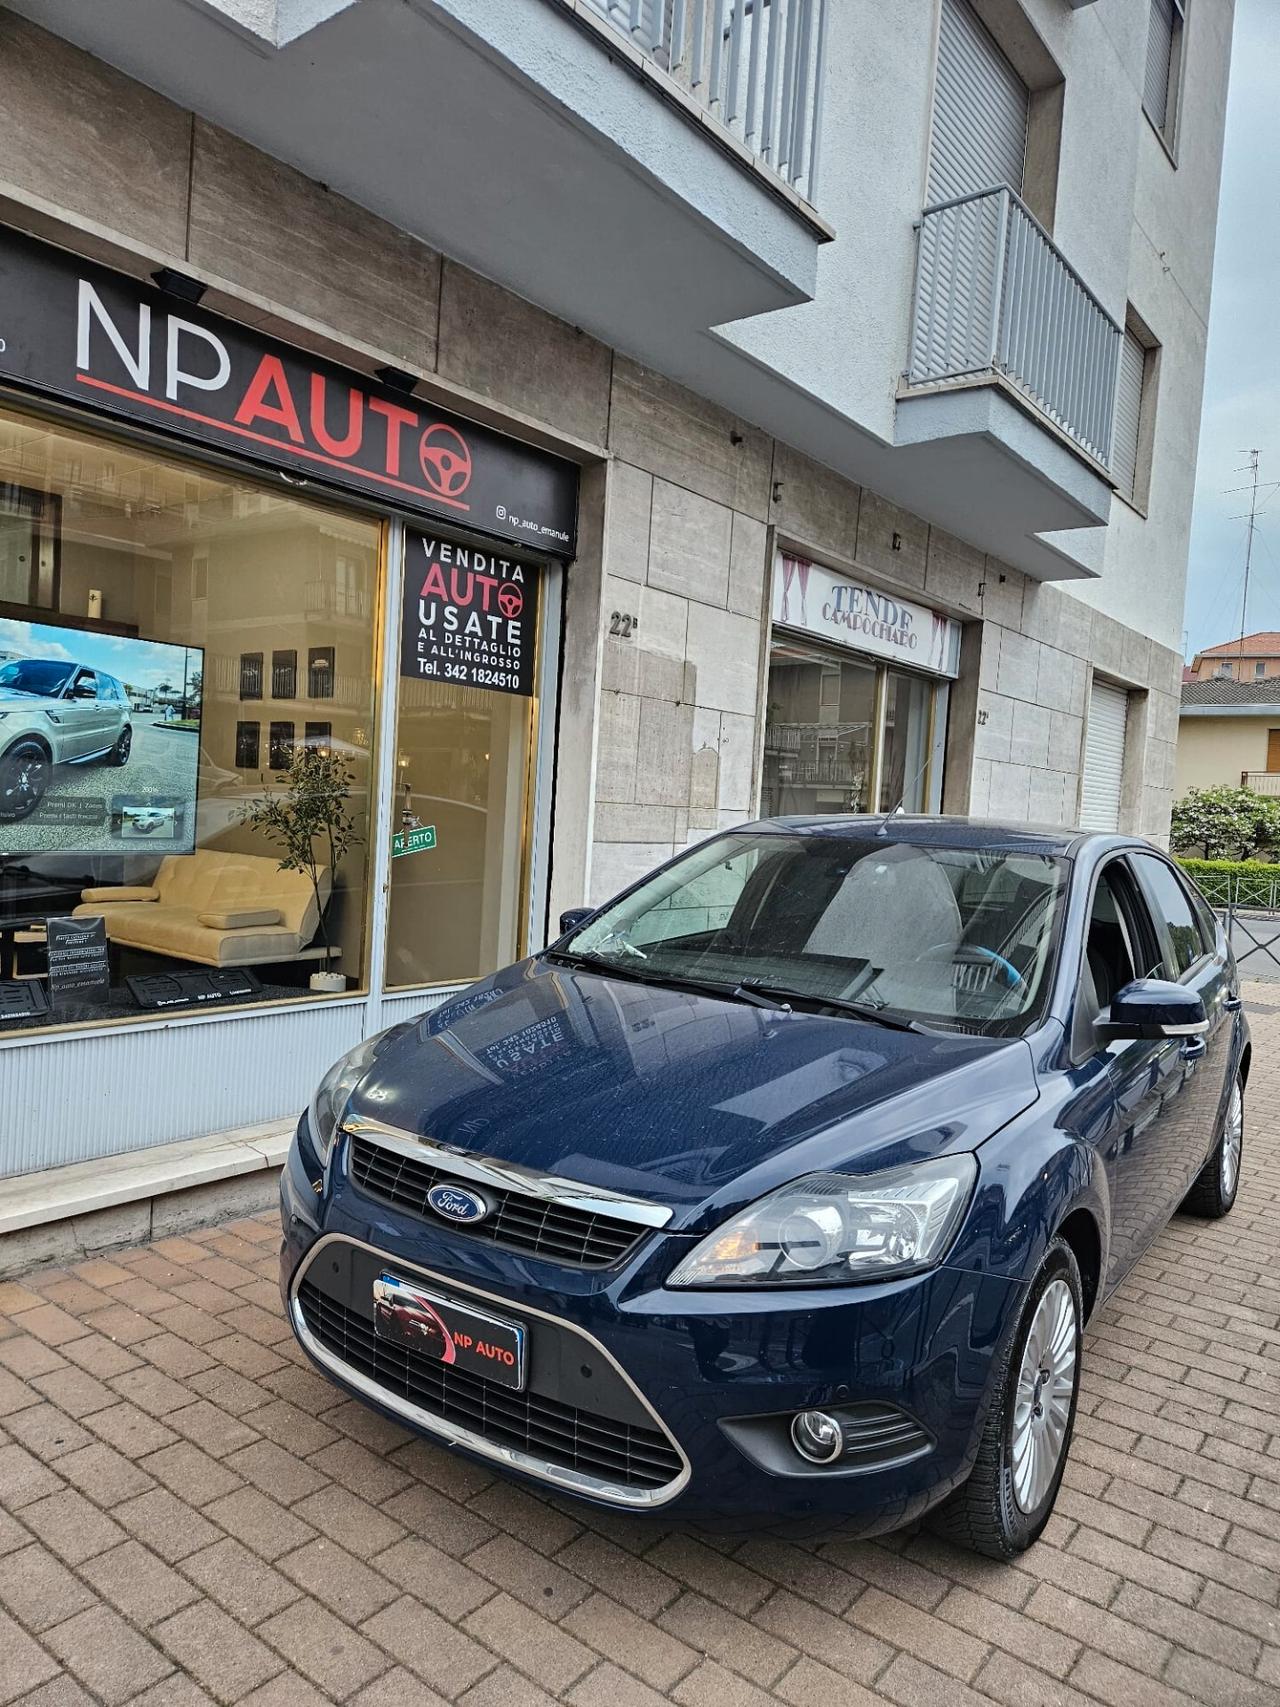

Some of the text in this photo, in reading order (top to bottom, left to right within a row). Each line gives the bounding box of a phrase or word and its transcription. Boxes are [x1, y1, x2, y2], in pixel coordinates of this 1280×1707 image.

[76, 279, 471, 497] NP AUTO
[422, 537, 524, 583] VENDITA
[420, 563, 523, 618] AUTO
[831, 585, 913, 630] TENDE
[418, 599, 521, 645] USATE
[418, 628, 521, 657] AL DETTAGLIO
[418, 642, 520, 670] E ALL'INGROSSO
[417, 657, 520, 689] Tel. 342 1824510
[437, 1191, 470, 1215] Ford
[454, 1331, 515, 1366] NP AUTO
